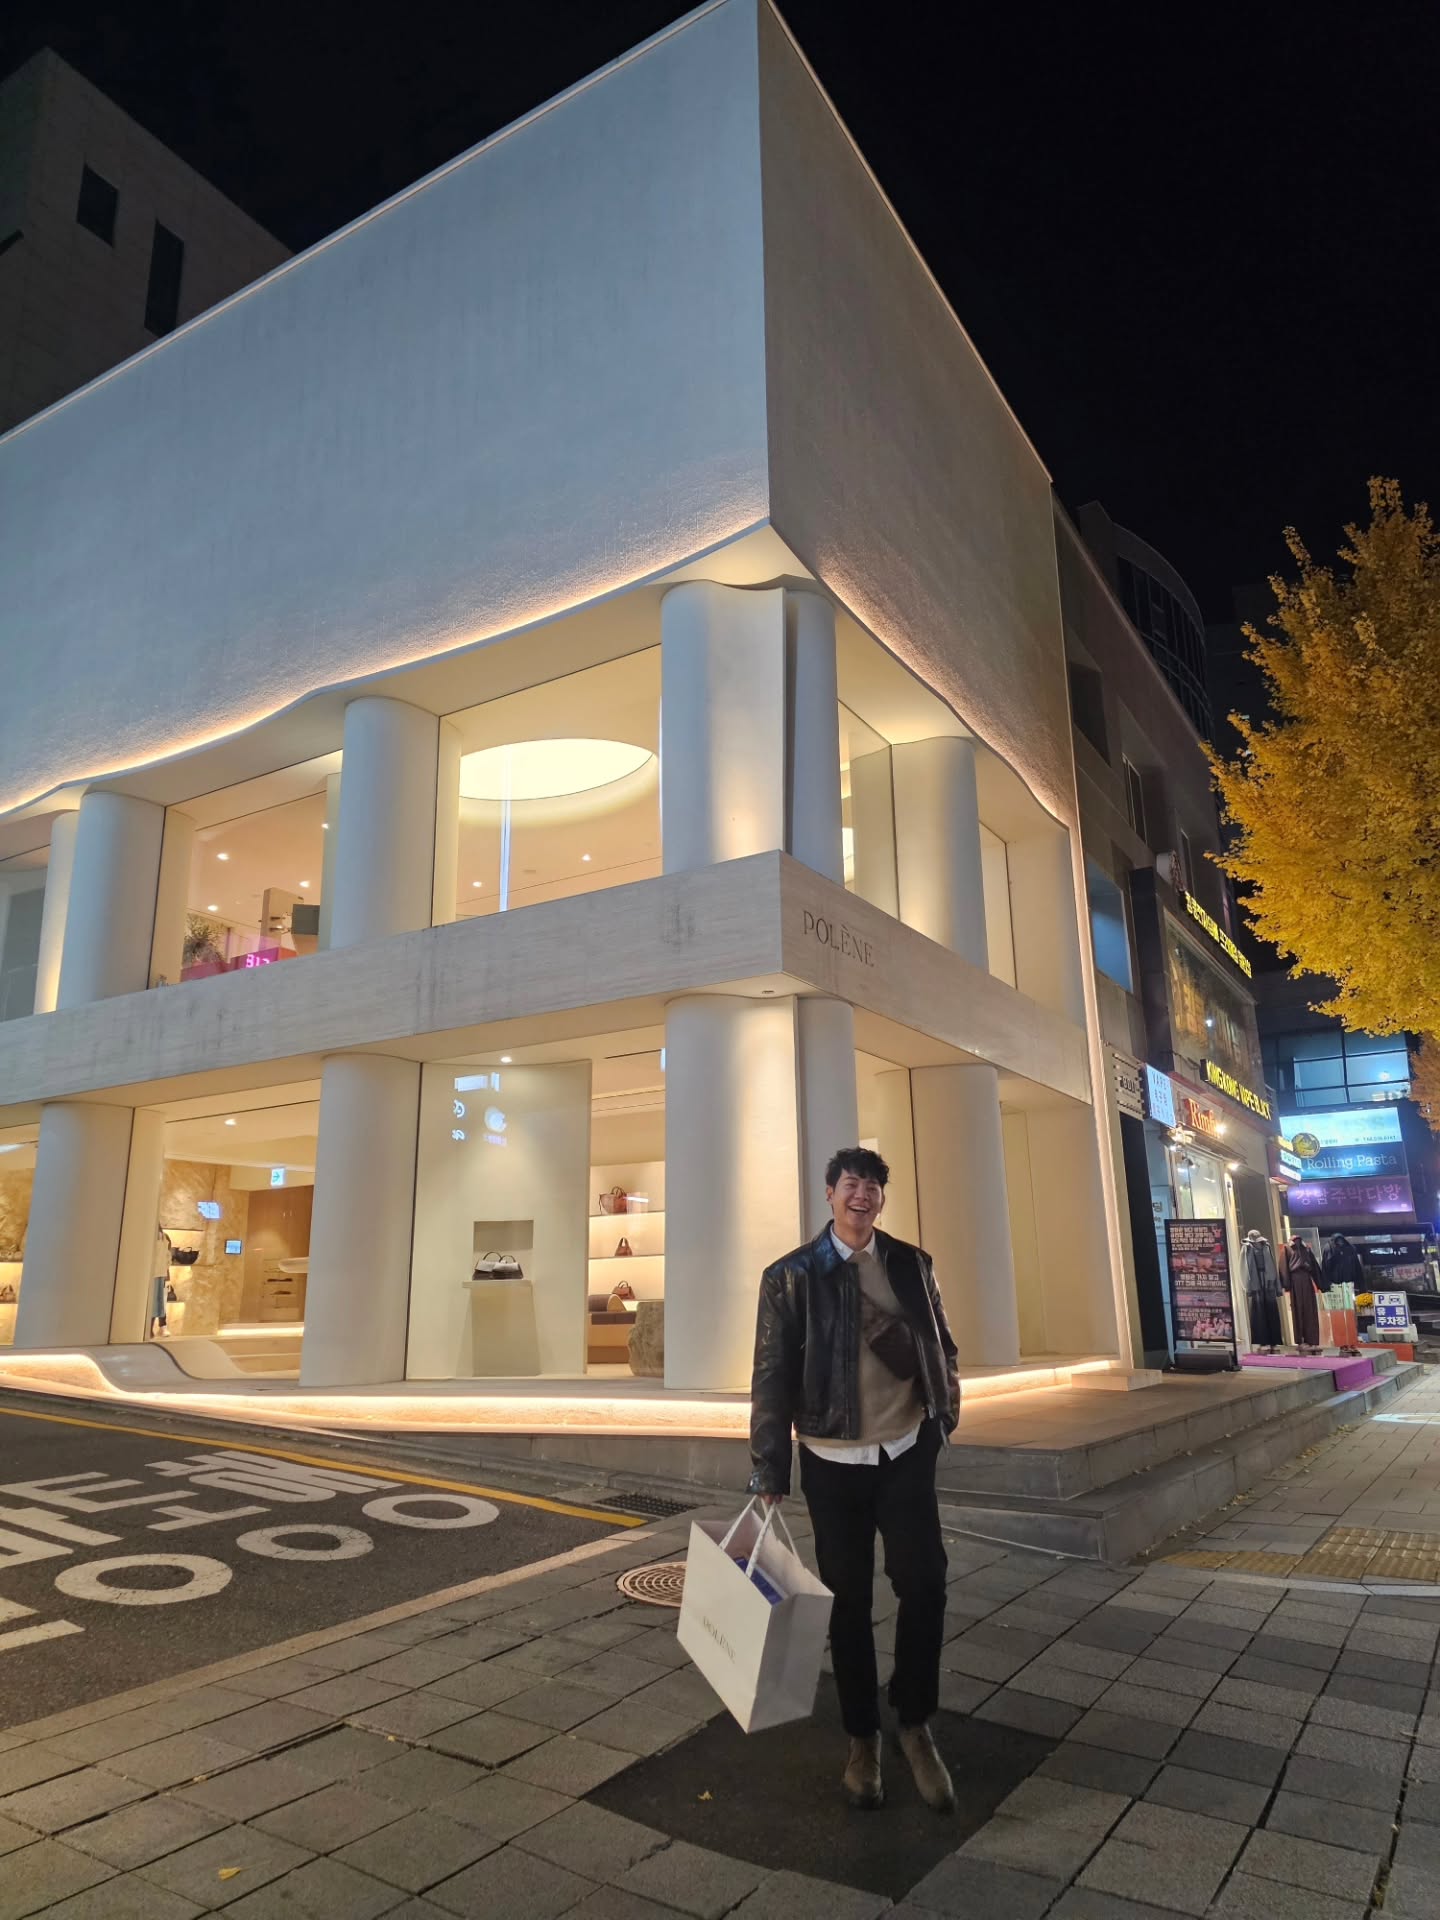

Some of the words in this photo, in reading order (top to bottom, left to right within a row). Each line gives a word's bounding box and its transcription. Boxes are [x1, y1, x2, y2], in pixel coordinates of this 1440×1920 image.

[803, 910, 875, 967] POLÈNE
[1307, 1155, 1353, 1170] Rolling
[1356, 1154, 1397, 1167] Pasta
[1378, 1295, 1385, 1305] P
[1377, 1316, 1406, 1326] 주차장
